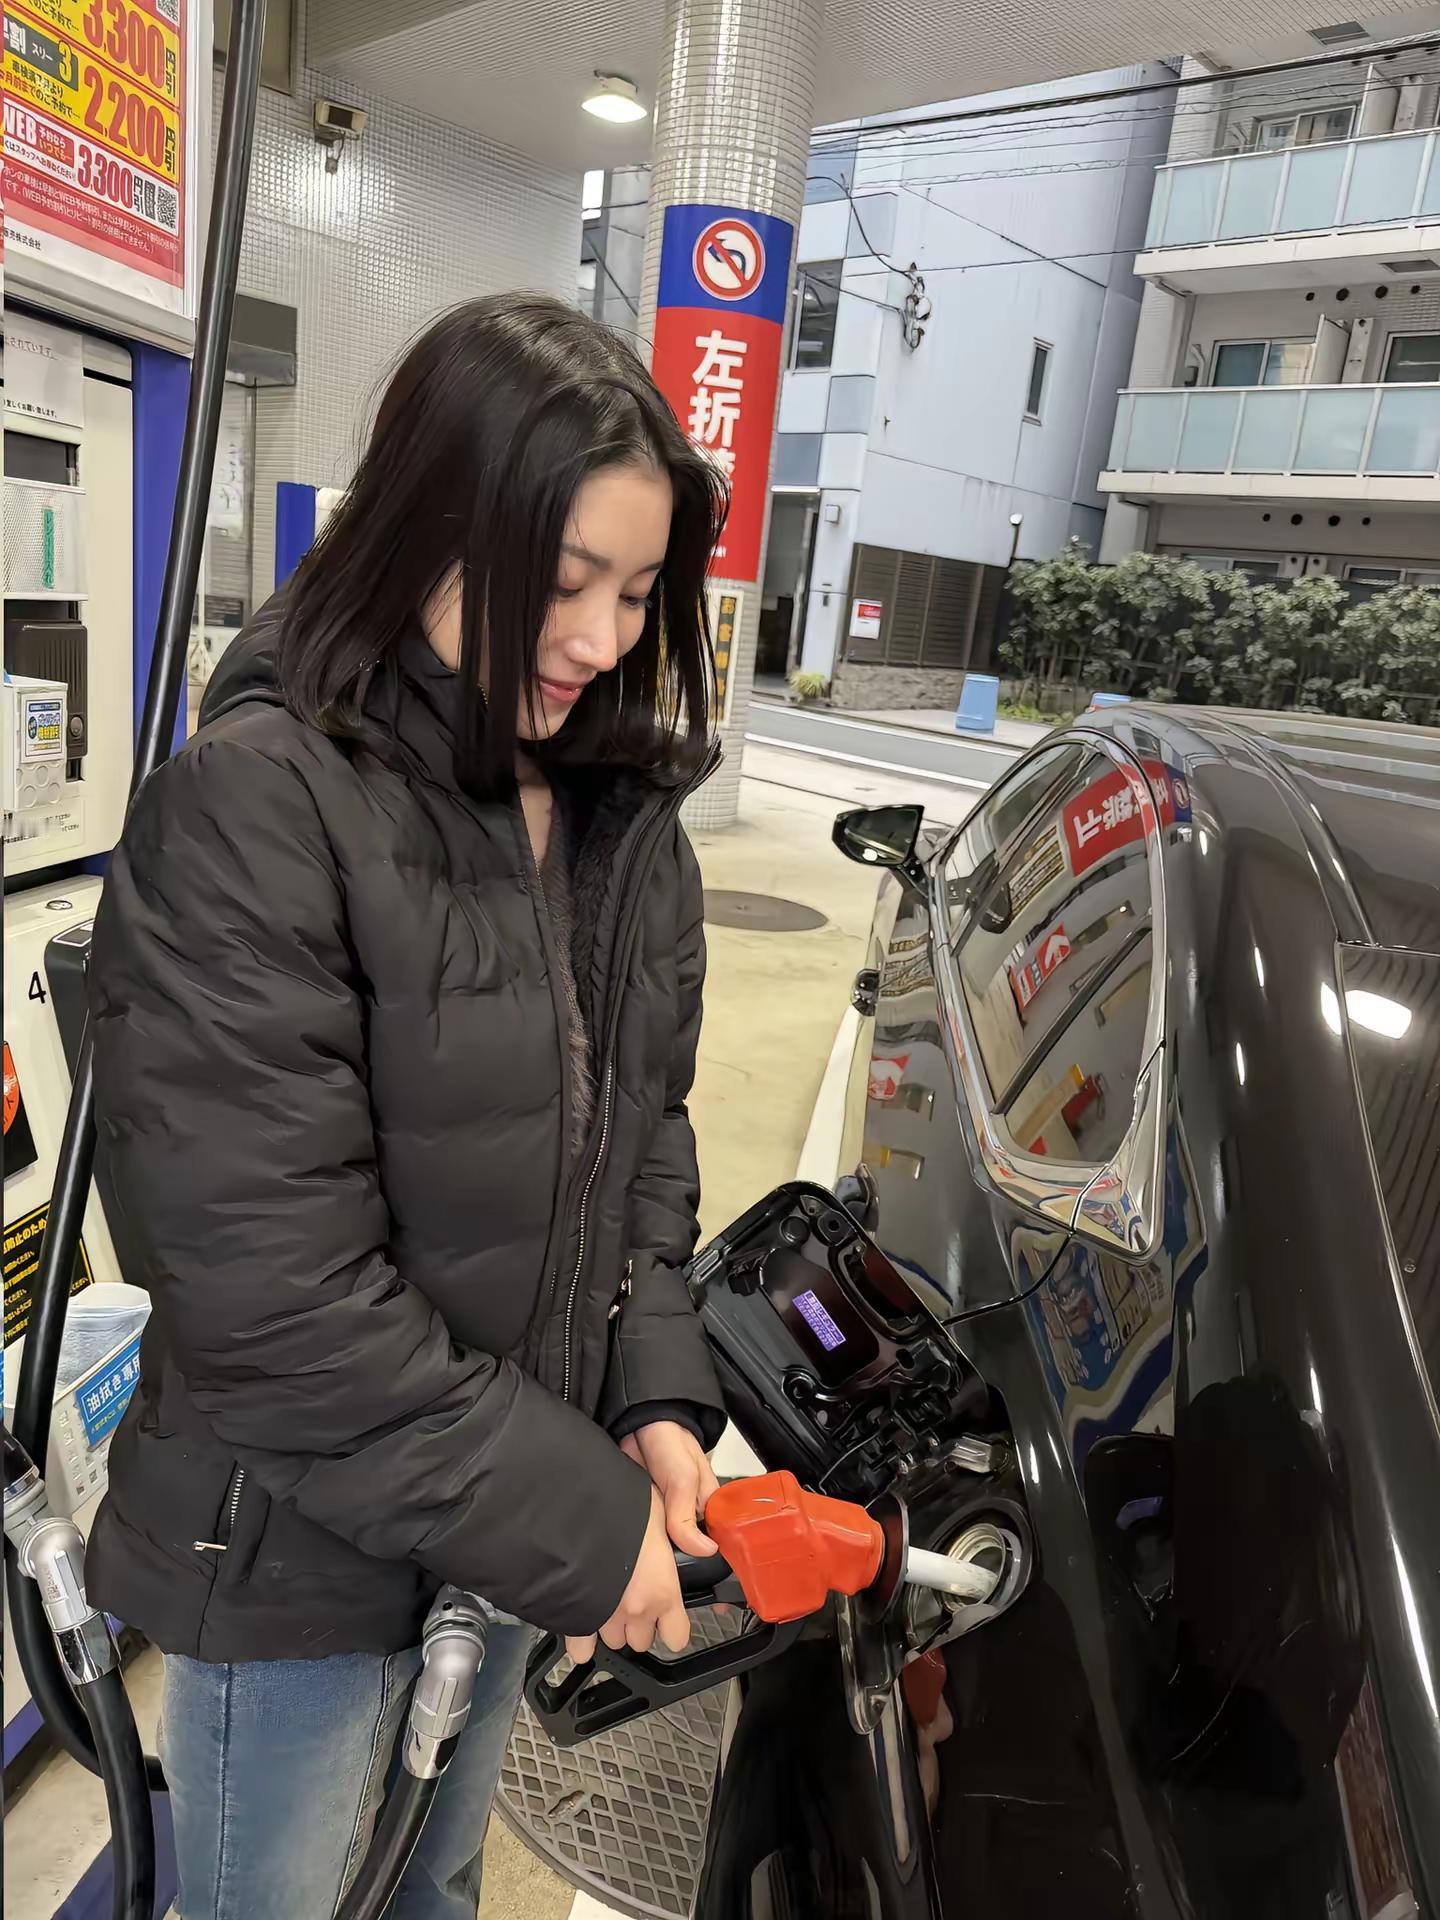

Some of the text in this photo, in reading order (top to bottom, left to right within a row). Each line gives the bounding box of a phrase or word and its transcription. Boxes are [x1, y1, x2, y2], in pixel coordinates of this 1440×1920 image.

[59, 40, 72, 82] 3
[83, 0, 165, 88] 3,300
[84, 65, 165, 168] 2,200
[78, 143, 133, 210] 3,300
[133, 175, 144, 215] 円引
[4, 399, 58, 418] 宜しくお願い致します。
[28, 971, 46, 1004] 4
